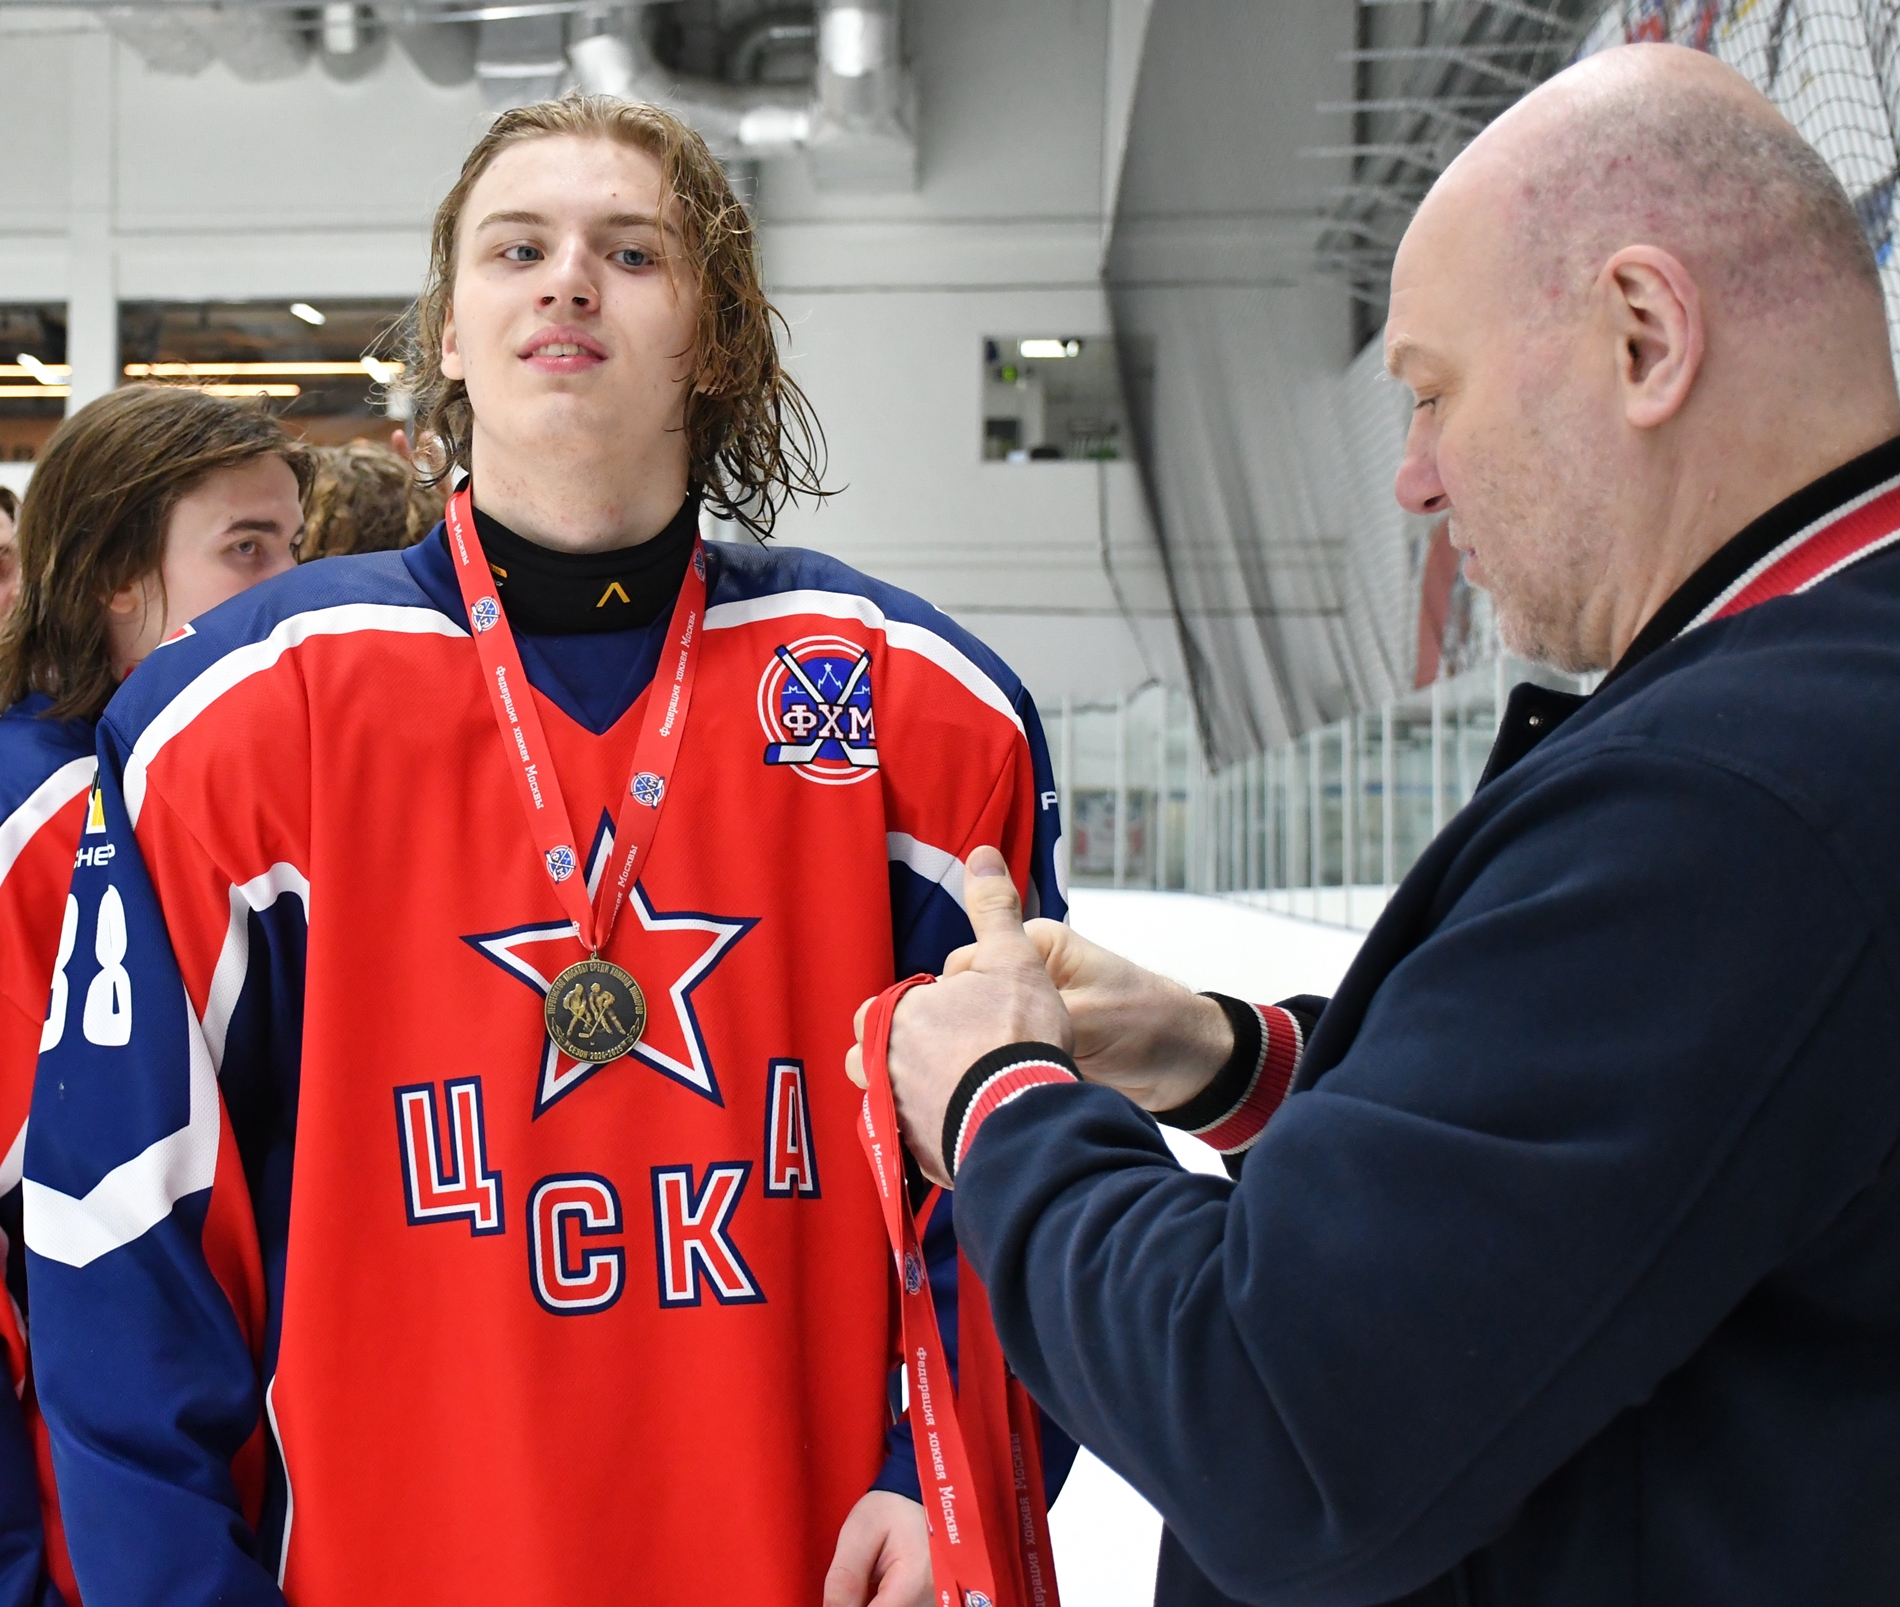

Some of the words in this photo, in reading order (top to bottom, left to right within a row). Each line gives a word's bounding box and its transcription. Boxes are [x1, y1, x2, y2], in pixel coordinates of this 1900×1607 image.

[453, 523, 470, 566] Москвы
[680, 611, 697, 649] Москвы
[675, 650, 688, 682] хоккея
[659, 684, 682, 737] Федерация
[782, 703, 876, 741] ФХМ
[495, 665, 519, 724] Федерация
[513, 726, 530, 762] хоккея
[525, 764, 544, 810] Москвы
[617, 844, 638, 888] Москвы
[562, 964, 588, 982] МОСКВЫ
[589, 963, 610, 974] СРЕДИ
[568, 1044, 589, 1060] СЕЗОН
[394, 1058, 821, 1317] ЦСКА
[872, 1143, 889, 1198] Москвы
[916, 1347, 935, 1426] Федерация
[928, 1431, 946, 1480] хоккея
[939, 1485, 960, 1545] Москвы
